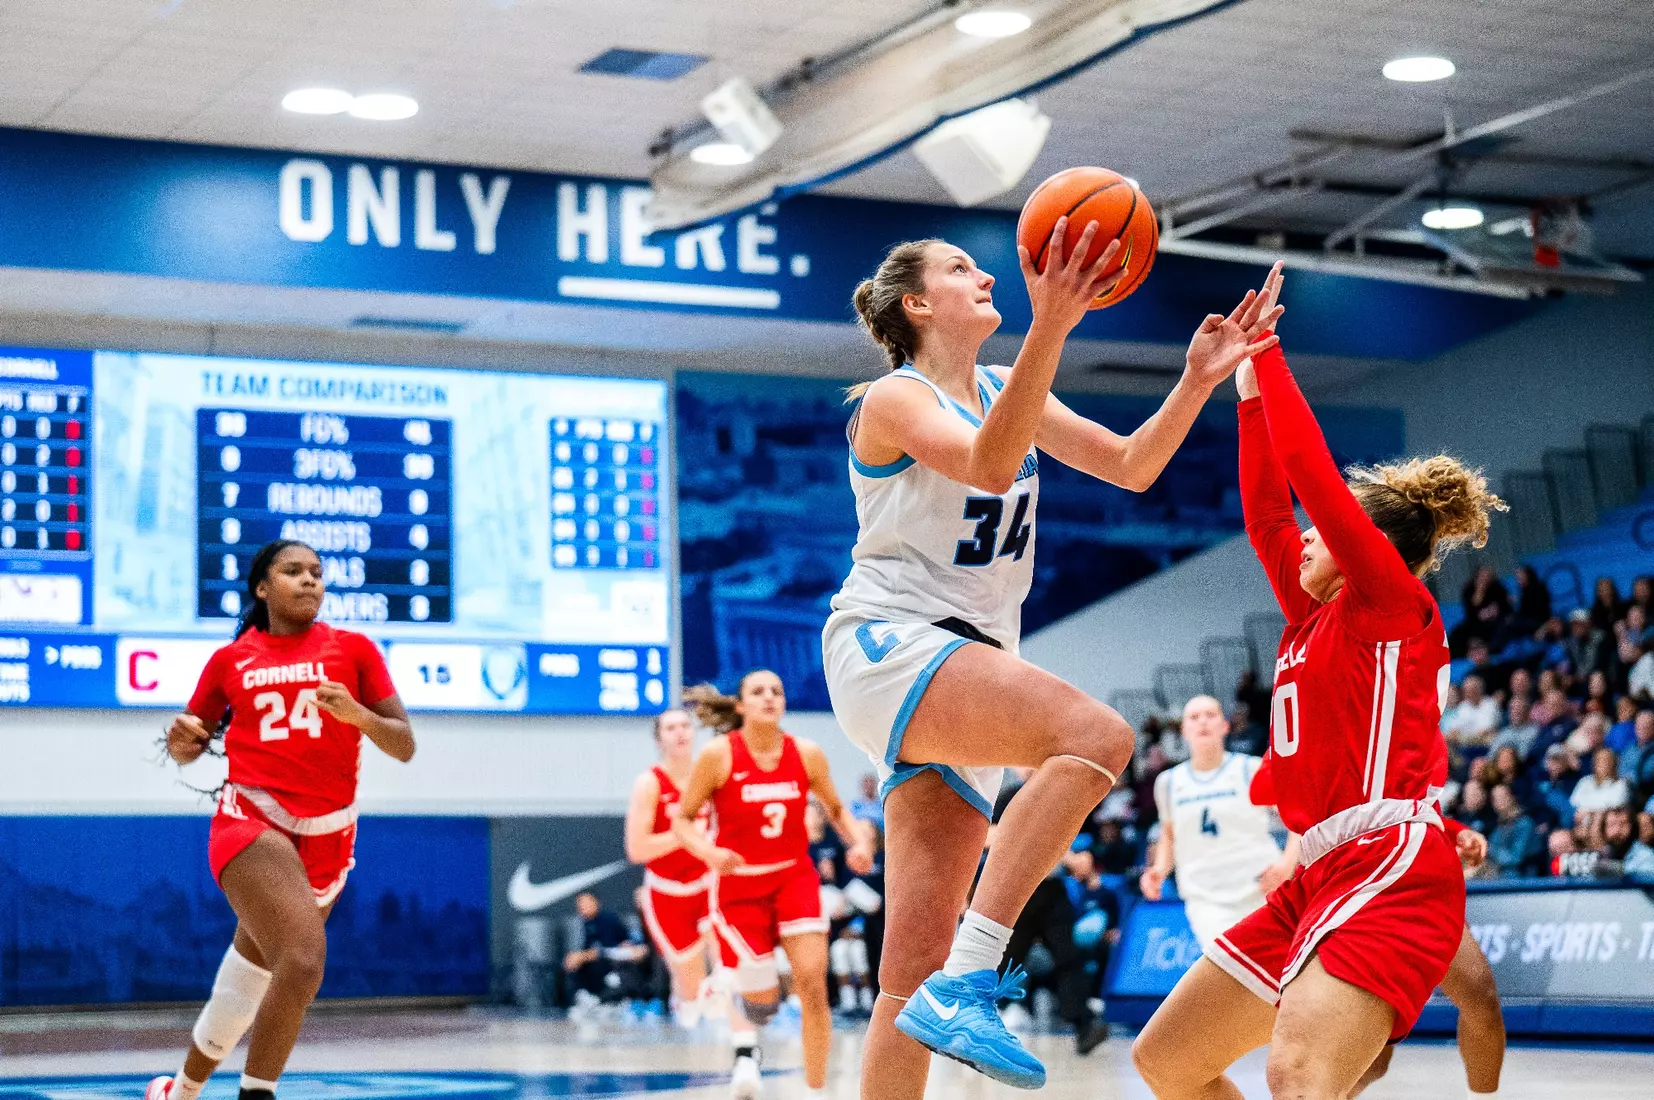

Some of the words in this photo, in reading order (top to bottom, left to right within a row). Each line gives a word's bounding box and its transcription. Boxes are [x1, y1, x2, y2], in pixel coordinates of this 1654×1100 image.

[278, 159, 510, 255] ONLY
[201, 371, 270, 398] TEAM
[278, 375, 449, 406] COMPARISON
[268, 482, 382, 517] REBOUNDS
[953, 492, 1030, 567] 34
[129, 650, 159, 691] C
[242, 662, 329, 690] CORNELL
[254, 688, 323, 742] 24
[1269, 681, 1299, 759] 0
[760, 802, 787, 839] 3
[1200, 807, 1219, 837] 4
[1520, 922, 1622, 963] SPORTS
